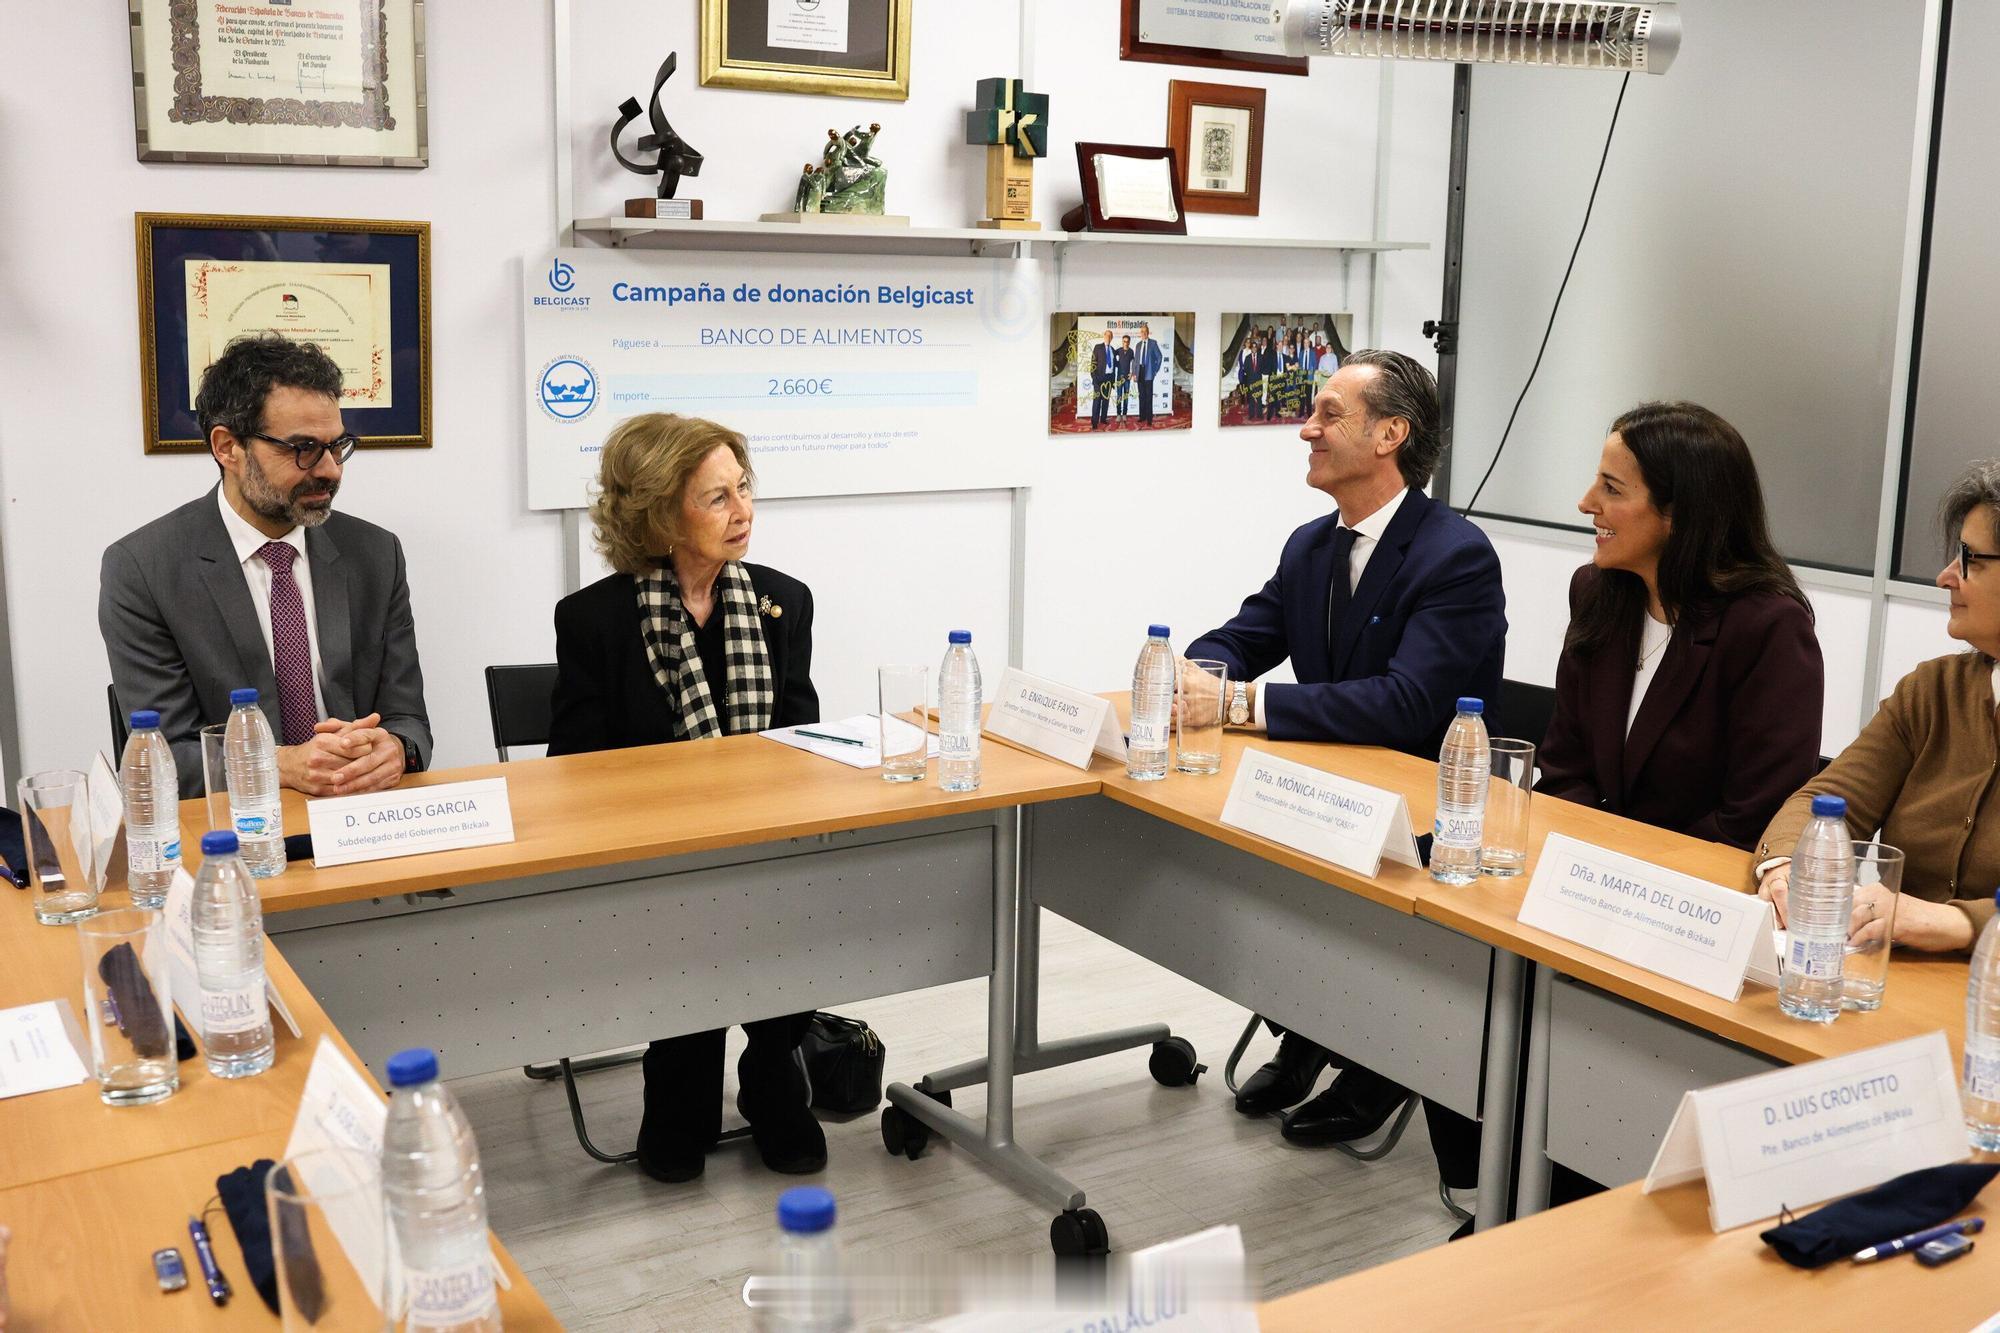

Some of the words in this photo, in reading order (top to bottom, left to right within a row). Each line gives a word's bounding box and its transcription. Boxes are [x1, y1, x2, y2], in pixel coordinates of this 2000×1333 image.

[533, 296, 591, 306] BELGICAST
[612, 282, 725, 307] Campaña
[732, 283, 761, 302] de
[768, 283, 870, 303] donación
[877, 285, 974, 308] Belgicast
[612, 338, 652, 350] Páguese
[701, 328, 774, 345] BANCO
[781, 328, 807, 345] DE
[812, 328, 923, 345] ALIMENTOS
[613, 391, 650, 403] Importe
[768, 378, 833, 396] 2.660€
[1028, 691, 1058, 710] ENRIQUE
[1057, 701, 1079, 717] FAYOS
[1254, 769, 1274, 785] Dña.
[1276, 776, 1316, 800] MÓNICA
[1317, 789, 1373, 817] HERNANDO
[345, 815, 360, 828] D.
[368, 806, 422, 825] CARLOS
[425, 800, 477, 817] GARCIA
[337, 832, 392, 848] Subdelegado
[394, 829, 408, 840] del
[409, 825, 448, 839] Gobierno
[449, 824, 460, 832] en
[461, 820, 490, 831] Bizkaia
[1570, 863, 1596, 883] Dña.
[1600, 873, 1647, 901] MARTA
[1650, 890, 1674, 910] DEL
[1678, 900, 1722, 925] OLMO
[1560, 886, 1598, 905] Secretario
[1598, 898, 1622, 914] Banco
[1622, 908, 1633, 919] de
[1634, 912, 1673, 933] Alimentos
[1674, 926, 1686, 937] de
[1687, 929, 1716, 947] Bizkaia
[1763, 1106, 1782, 1126] D.
[1784, 1095, 1818, 1121] LUIS
[1820, 1074, 1899, 1110] CROVETTO
[1782, 1135, 1811, 1152] Banco
[1812, 1130, 1824, 1143] de
[1872, 1114, 1883, 1127] de
